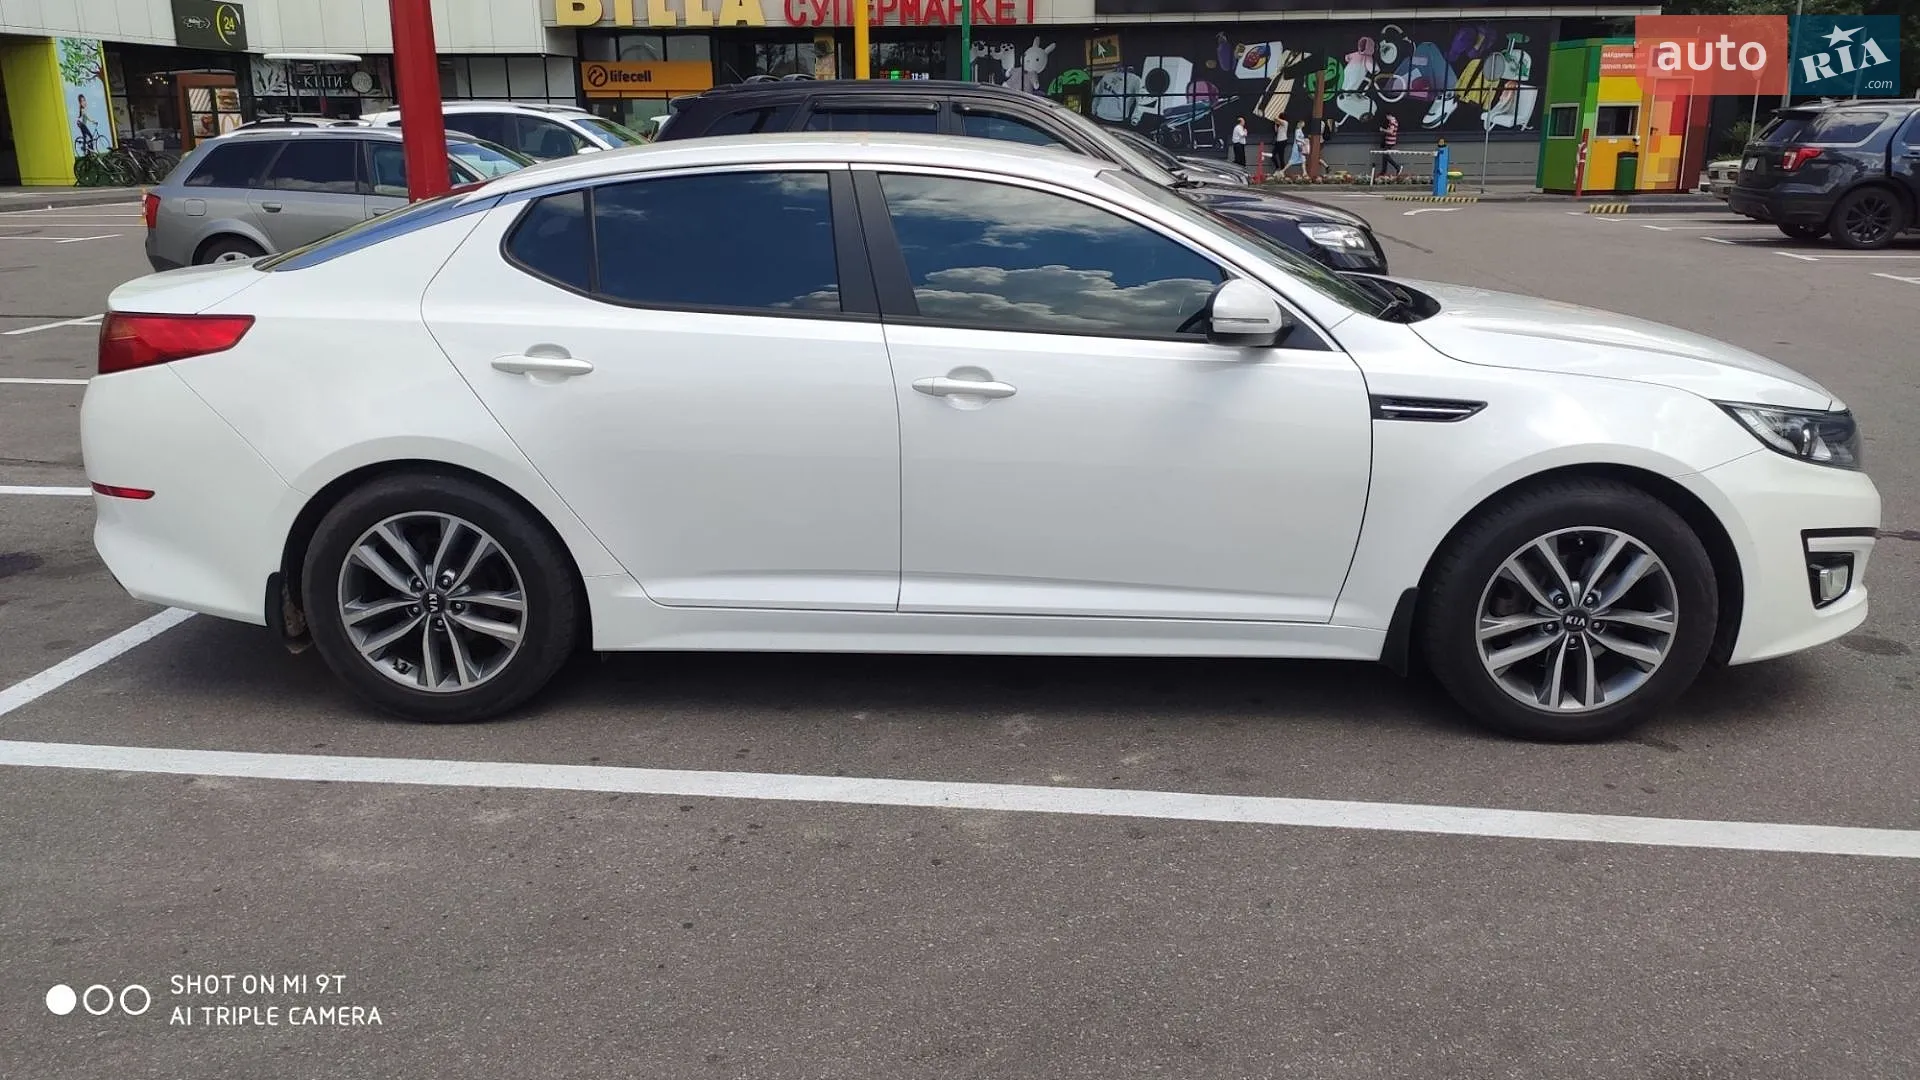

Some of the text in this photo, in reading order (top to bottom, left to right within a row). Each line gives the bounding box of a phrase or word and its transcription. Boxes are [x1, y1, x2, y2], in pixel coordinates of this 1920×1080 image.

[223, 16, 235, 30] 24
[610, 69, 652, 83] lifecell
[429, 594, 438, 612] KIA
[1566, 615, 1585, 626] KIA
